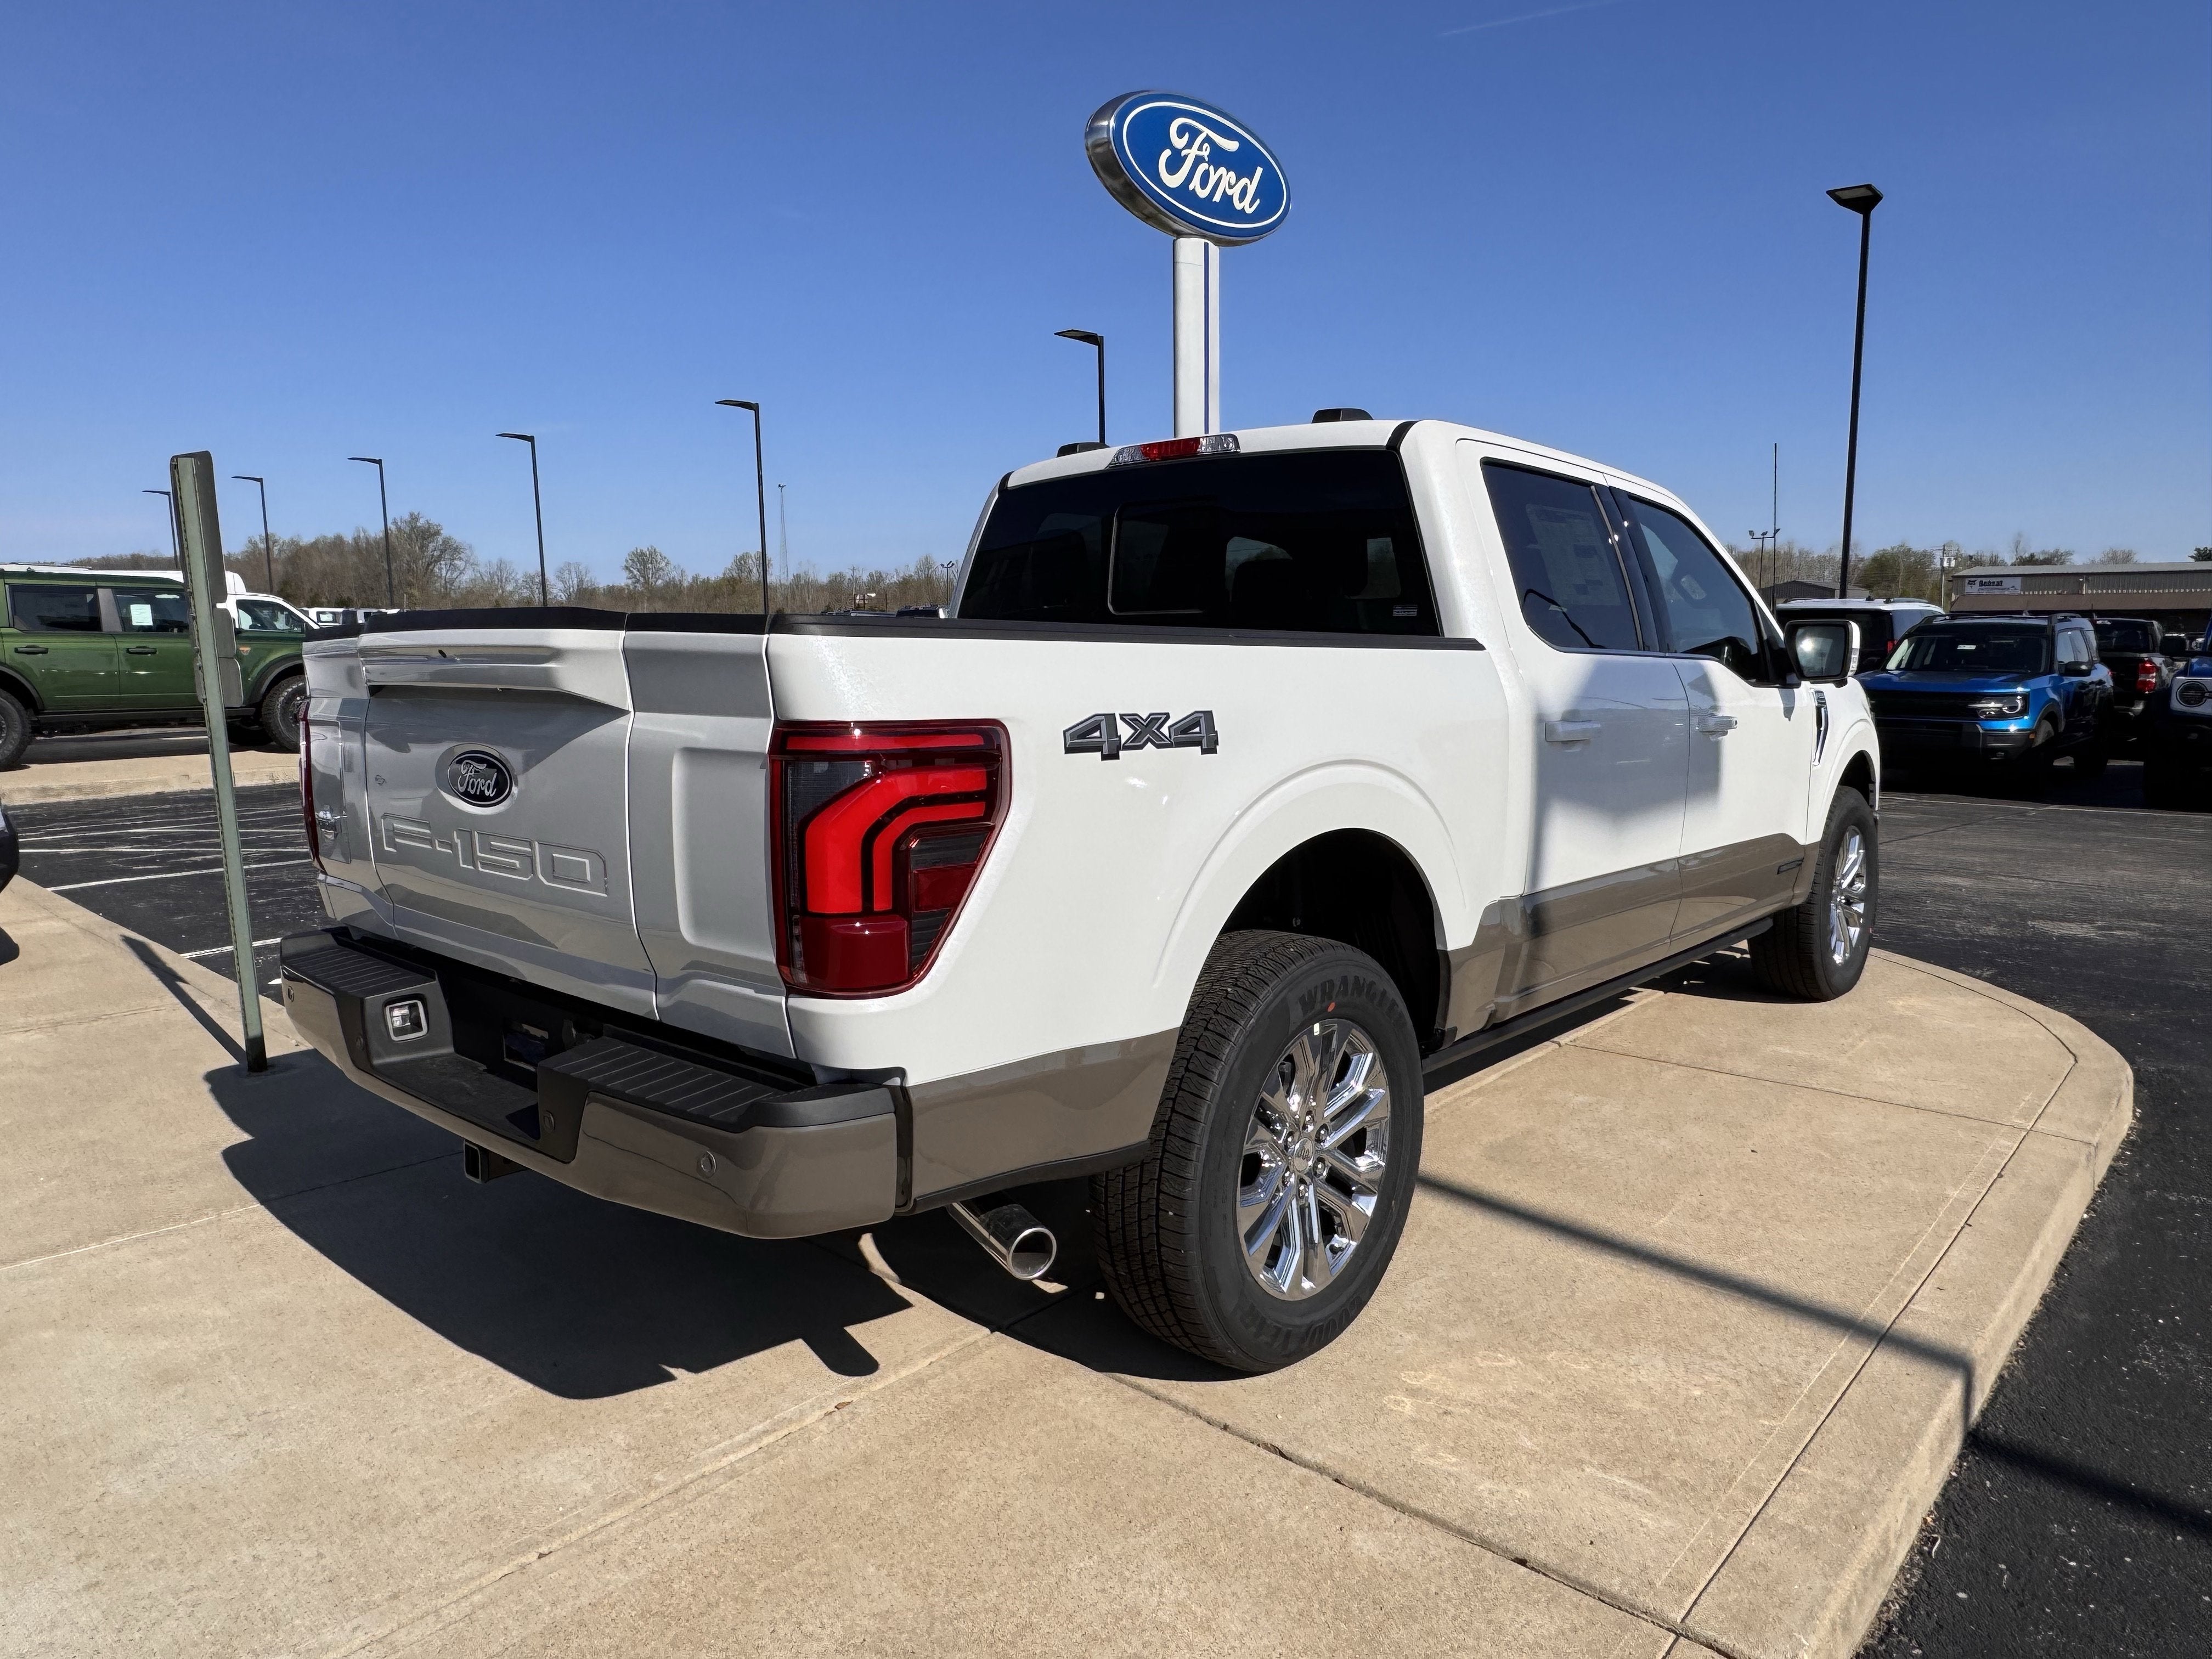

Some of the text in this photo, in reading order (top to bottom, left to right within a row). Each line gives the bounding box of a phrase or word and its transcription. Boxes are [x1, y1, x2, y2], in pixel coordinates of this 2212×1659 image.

[1158, 117, 1263, 214] Ford
[458, 759, 497, 797] Ford
[381, 812, 608, 898] F-150
